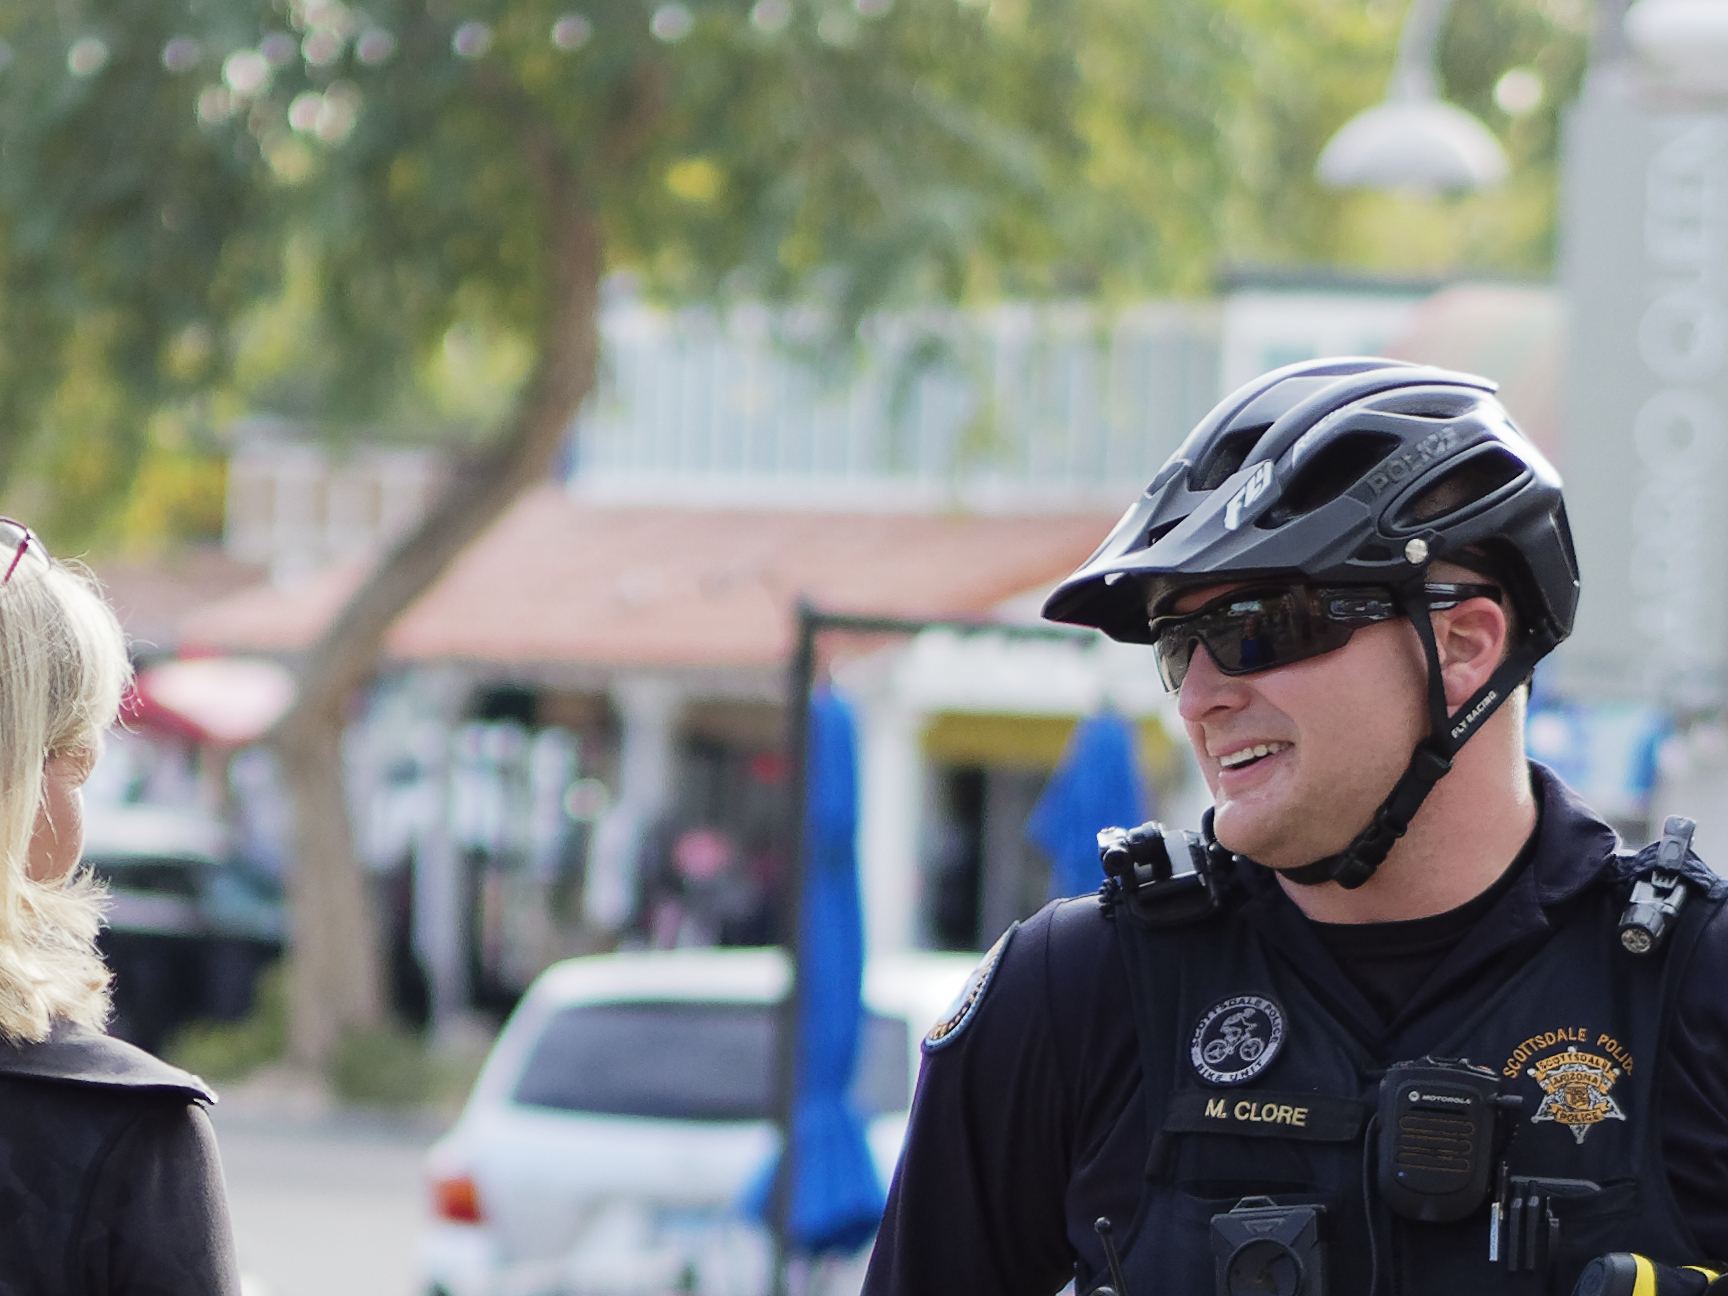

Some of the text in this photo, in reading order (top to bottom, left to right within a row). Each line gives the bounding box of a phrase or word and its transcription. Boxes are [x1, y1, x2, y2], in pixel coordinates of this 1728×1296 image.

[1368, 425, 1458, 496] POLICE
[1224, 459, 1273, 531] FLY
[1502, 1027, 1588, 1080] SCOTTSDALE
[1553, 1073, 1601, 1087] ARIZONA
[1204, 1098, 1309, 1128] M. CLORE
[1421, 1093, 1472, 1105] MOTOROLA
[1559, 1110, 1600, 1123] POLICE
